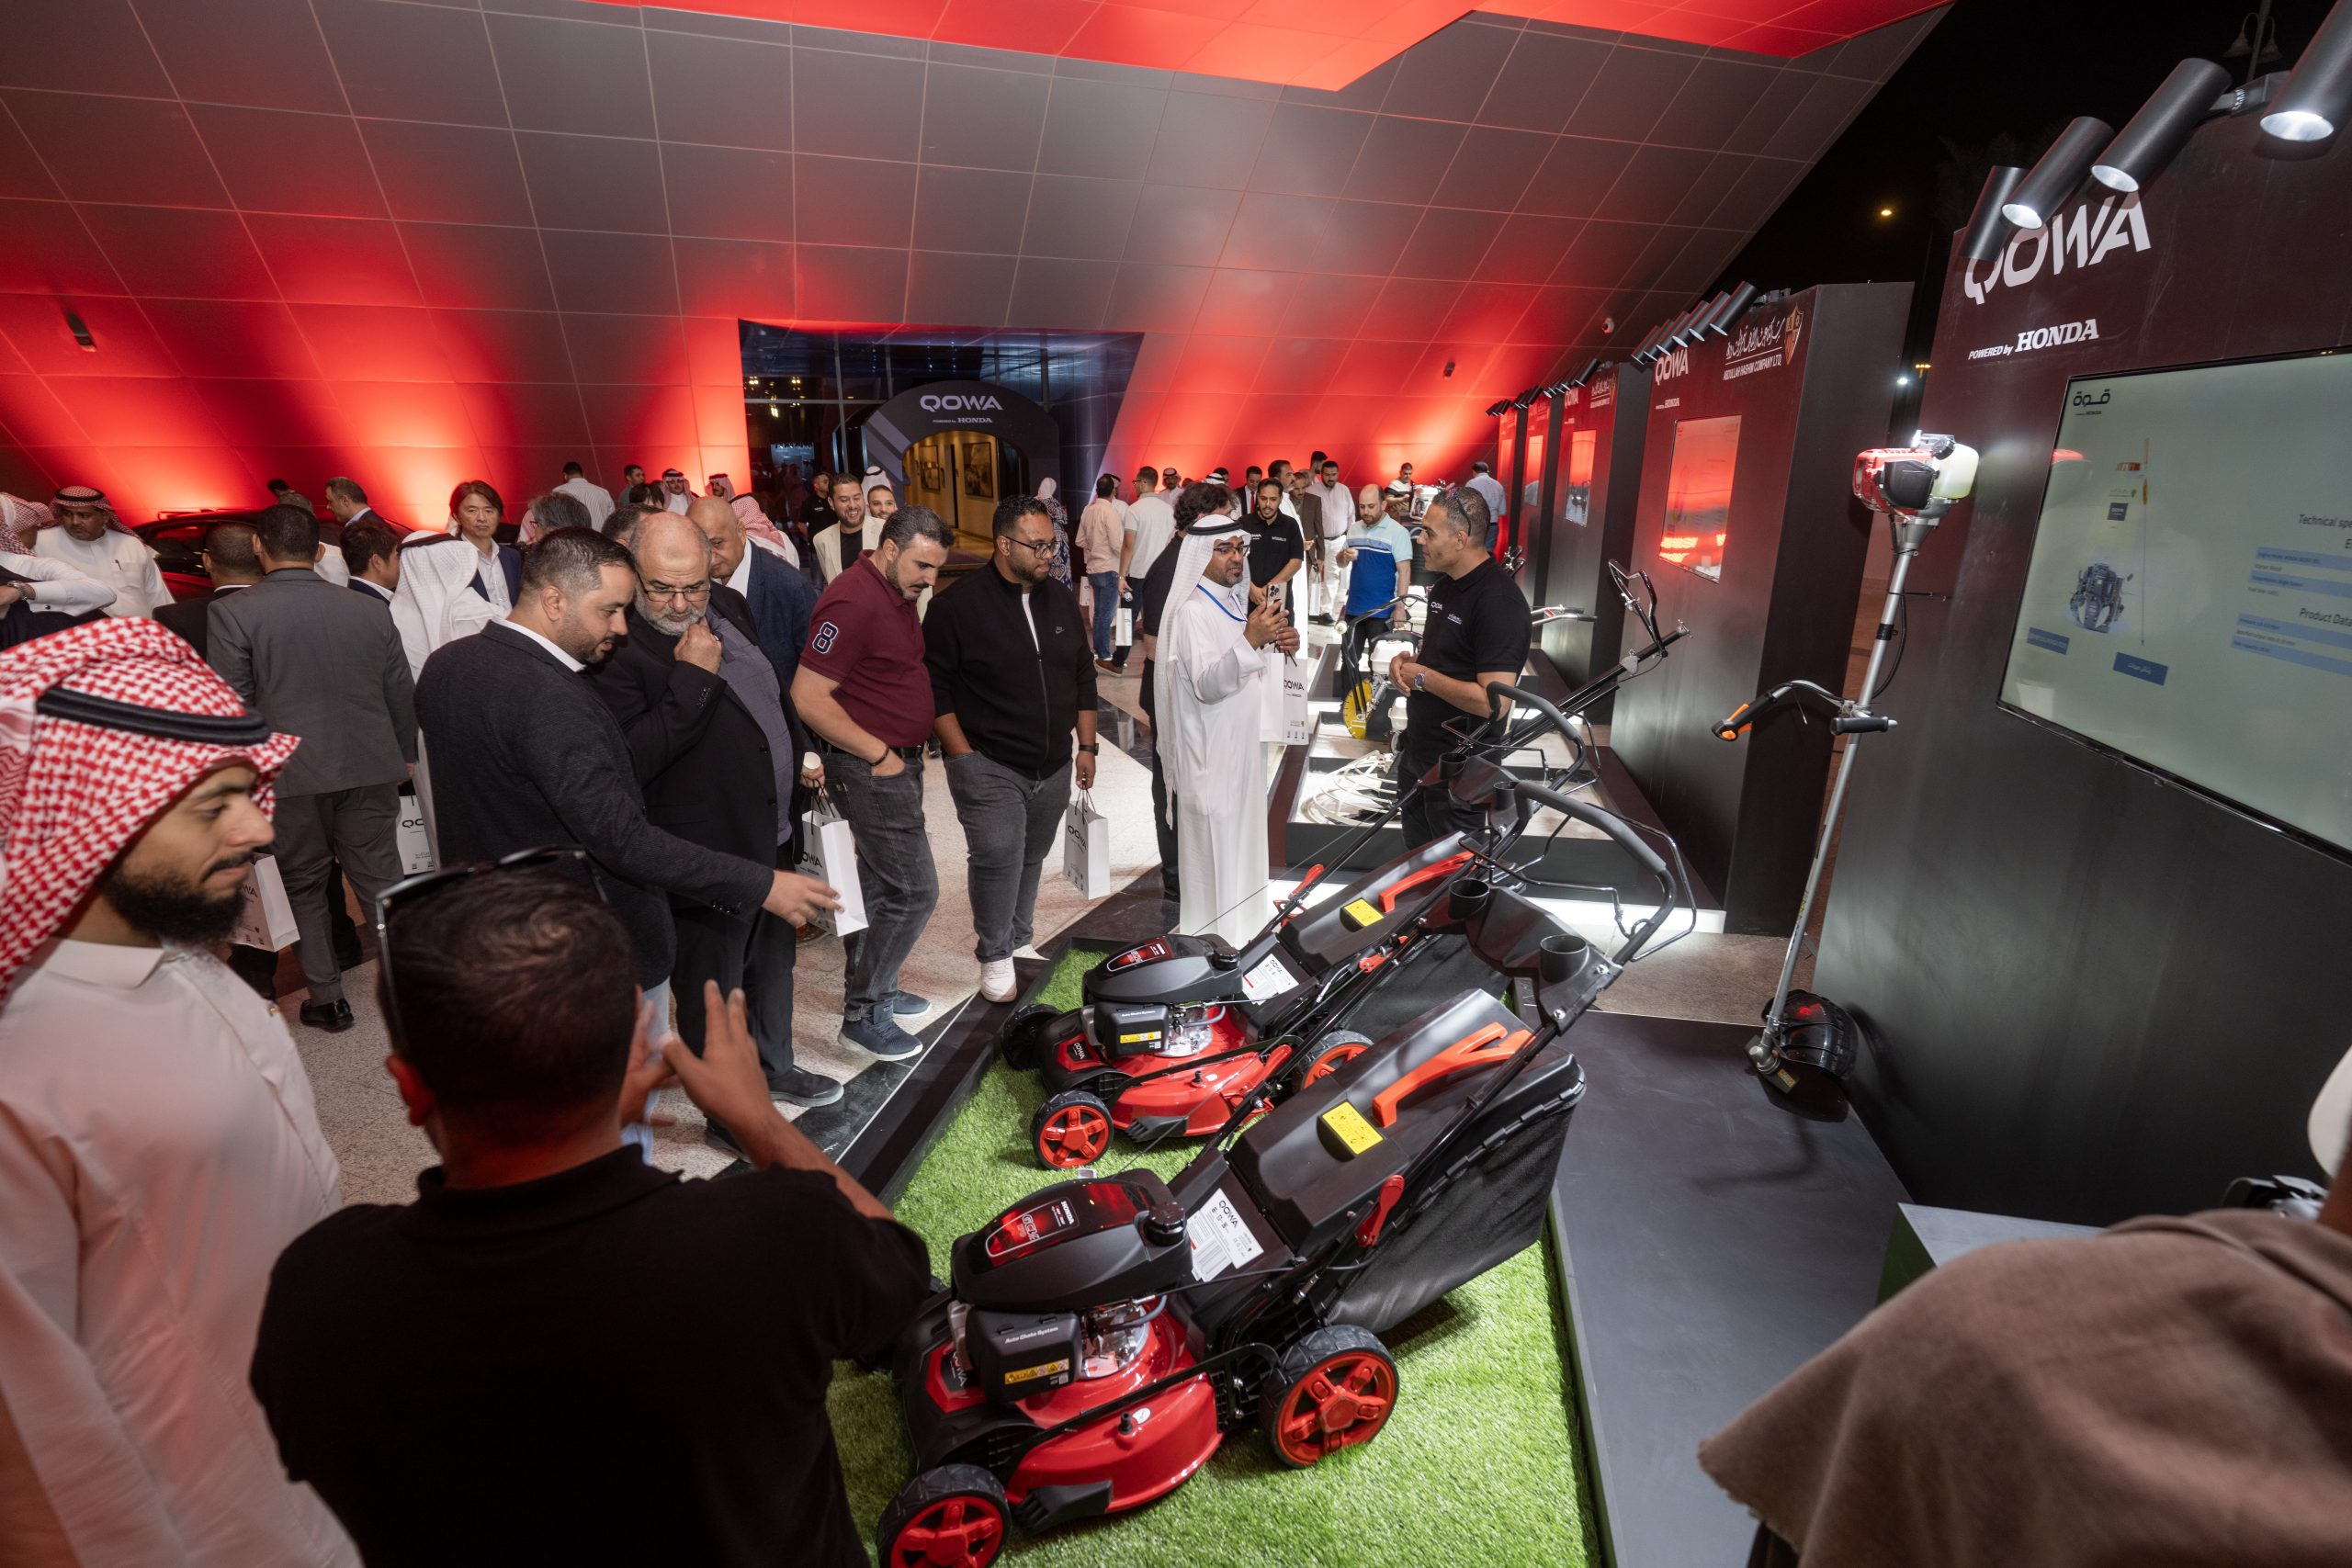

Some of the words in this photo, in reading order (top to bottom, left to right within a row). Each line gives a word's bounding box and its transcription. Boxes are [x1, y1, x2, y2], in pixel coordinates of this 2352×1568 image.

[1964, 191, 2152, 305] QOWA
[1968, 345, 2003, 360] POWERED
[2002, 344, 2014, 356] by
[2014, 319, 2099, 353] HONDA
[1656, 348, 1689, 386] QOWA
[920, 395, 1004, 412] QOWA
[2299, 513, 2338, 527] Technical
[2299, 607, 2333, 624] Product
[812, 621, 839, 654] 8
[1067, 825, 1088, 852] QOWA
[802, 851, 823, 868] OWA
[1060, 1200, 1075, 1225] HONDA
[1218, 1200, 1239, 1228] QOWA
[1004, 1336, 1020, 1344] Auto
[1019, 1331, 1037, 1341] Choke
[1036, 1325, 1059, 1336] System
